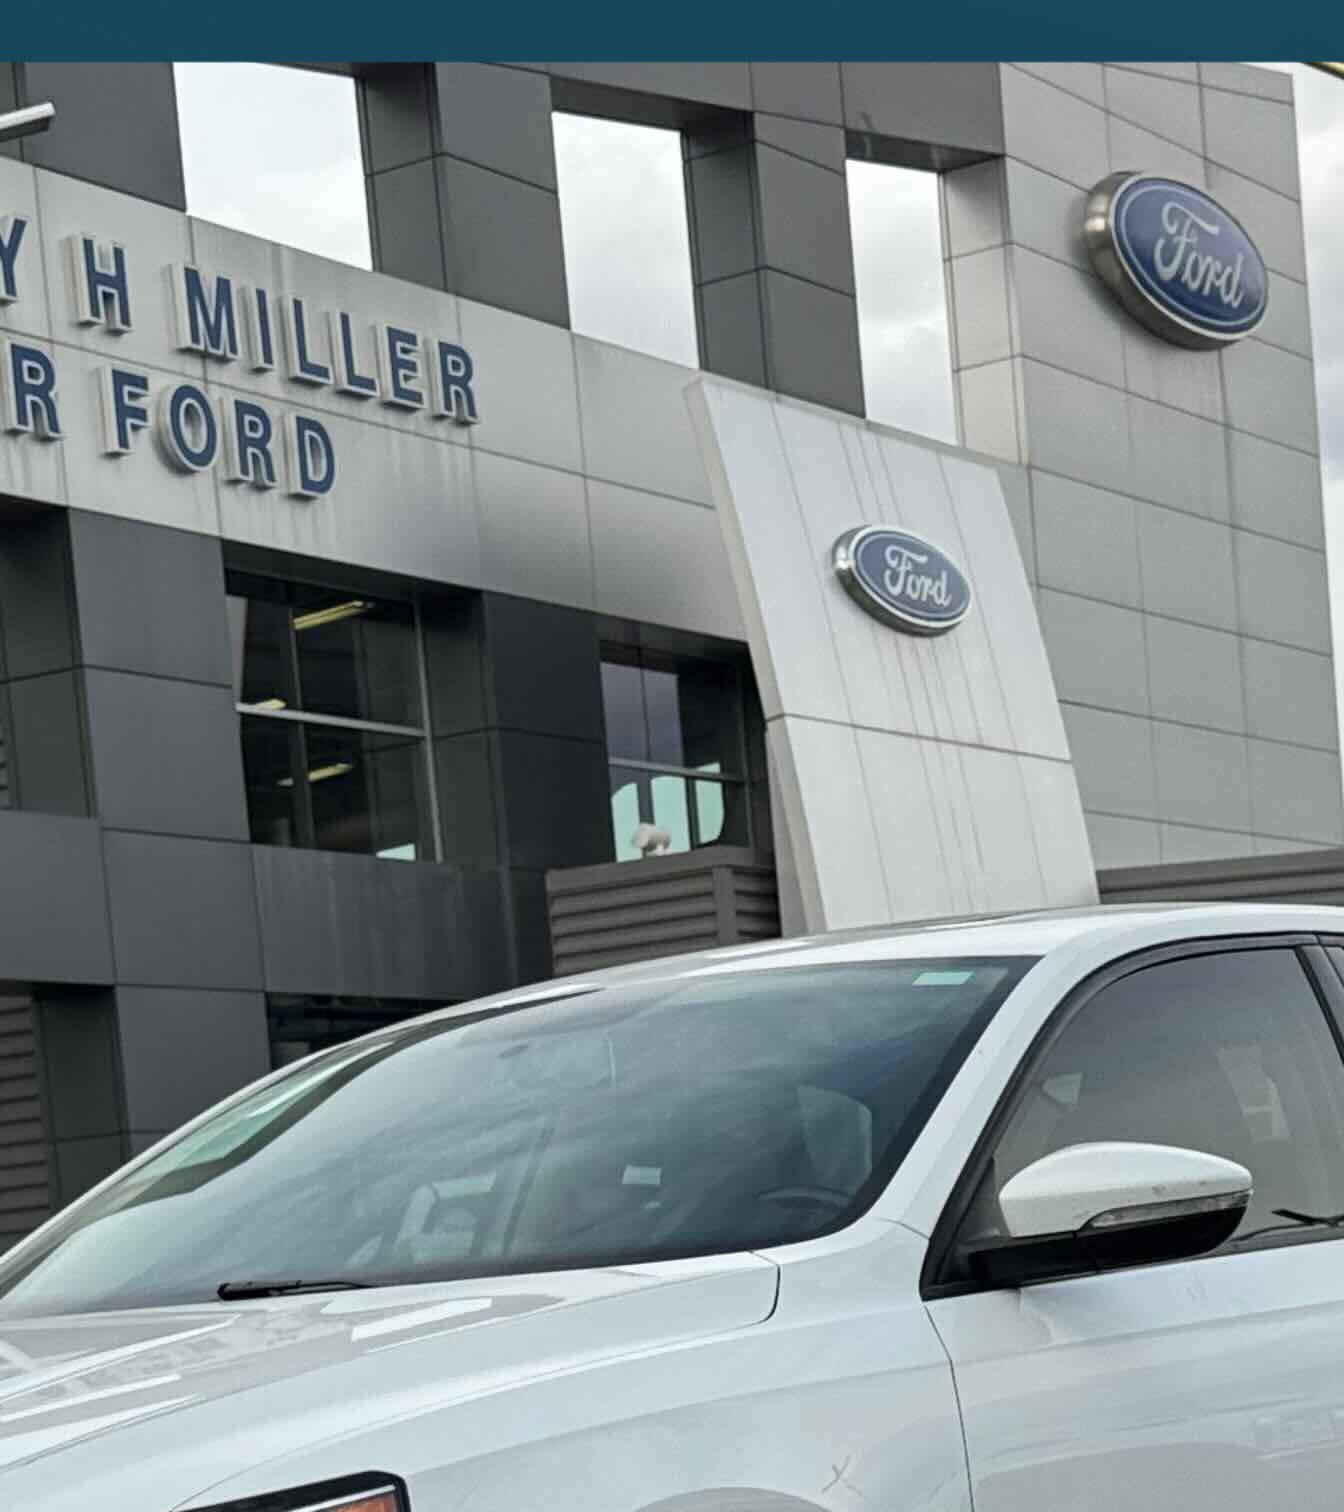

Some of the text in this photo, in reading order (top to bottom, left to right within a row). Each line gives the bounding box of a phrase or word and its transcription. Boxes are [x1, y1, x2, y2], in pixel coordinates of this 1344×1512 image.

[1153, 200, 1246, 309] Ford
[74, 235, 133, 334] H
[176, 260, 479, 424] MILLER
[102, 366, 337, 496] FORD
[883, 543, 953, 608] Ford
